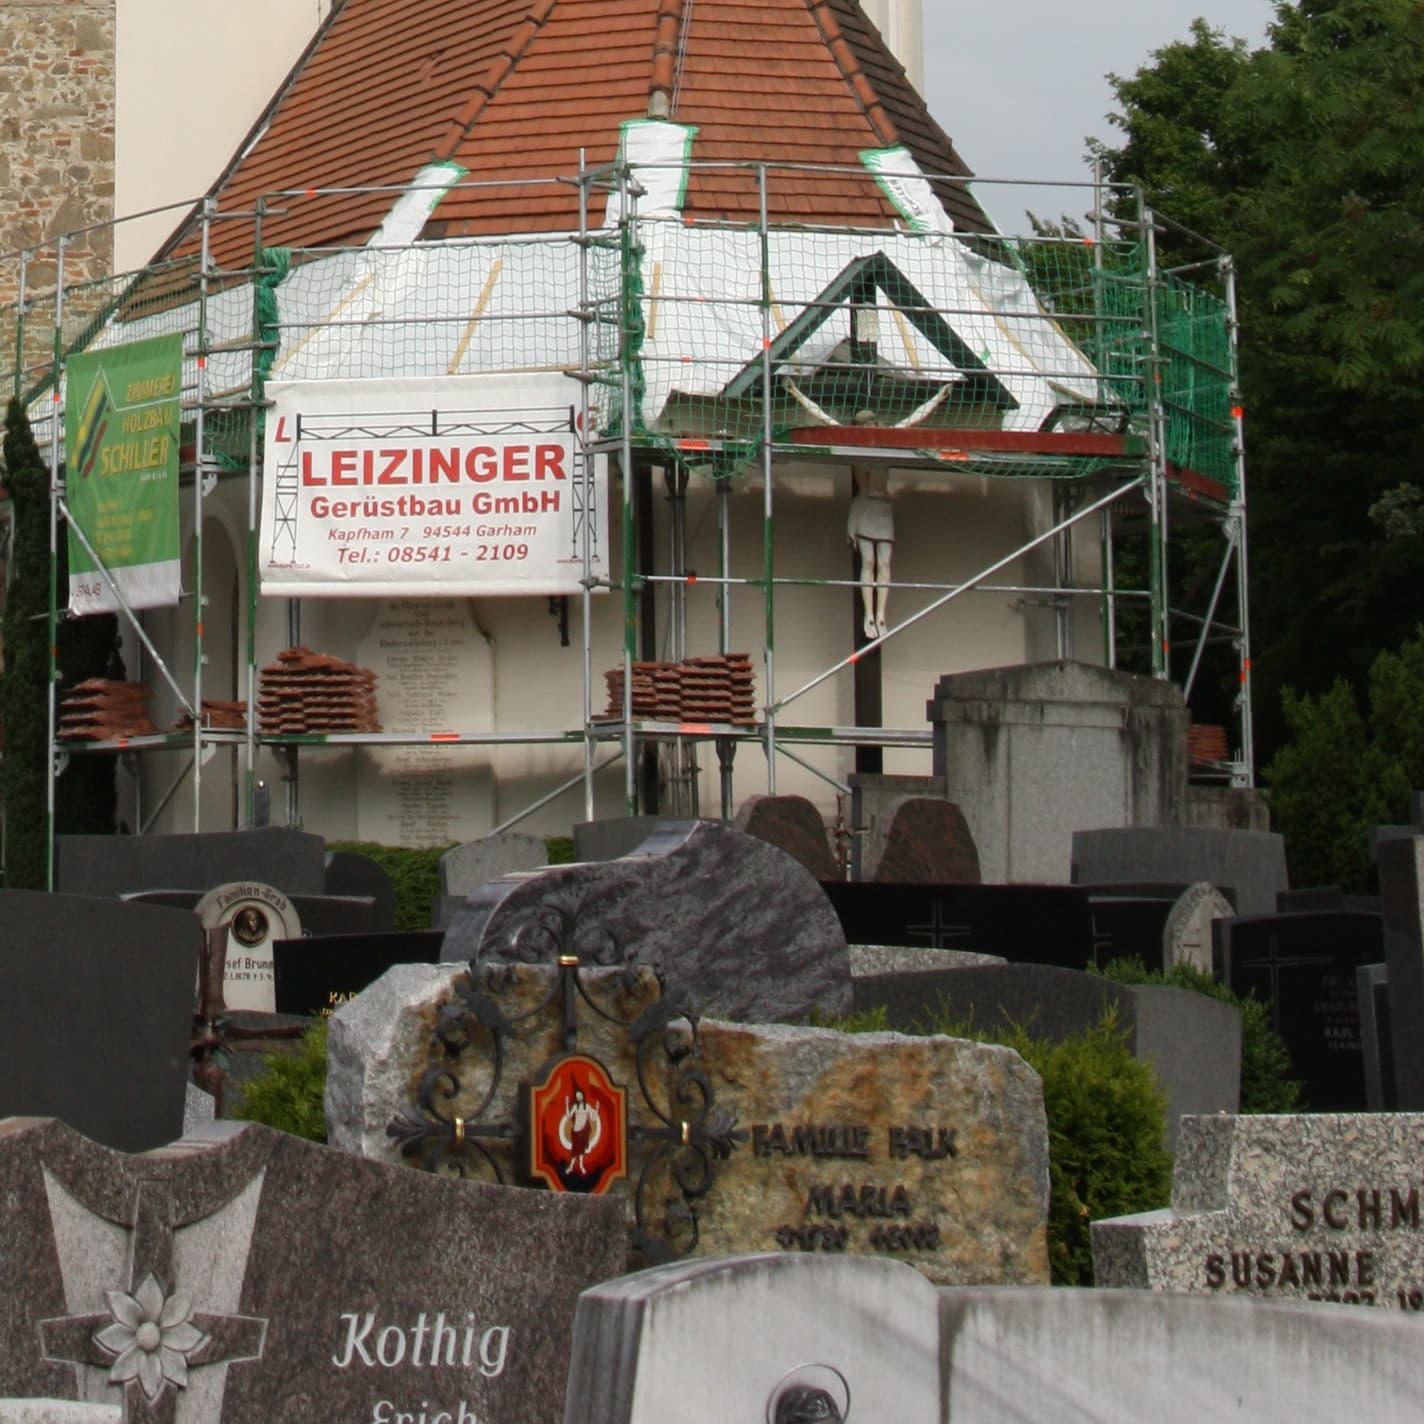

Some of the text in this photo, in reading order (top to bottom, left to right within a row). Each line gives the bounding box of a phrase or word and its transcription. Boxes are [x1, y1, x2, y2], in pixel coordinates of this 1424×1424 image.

[125, 374, 176, 403] ZIMMEREI
[123, 406, 172, 435] HOLZBAU
[275, 416, 292, 443] L
[100, 436, 169, 476] SCHILLER
[302, 444, 567, 487] LEIZINGER
[310, 490, 560, 518] Gerüstbau GmbH
[328, 524, 536, 543] Kapfham 7 94544 Garham
[337, 547, 378, 563] Tel.:
[387, 545, 451, 562] 08541
[476, 543, 528, 561] 2109
[751, 1123, 871, 1158] FAMILIE
[805, 1183, 913, 1218] MARIA
[1206, 1250, 1376, 1288] SUSANNE
[331, 1312, 512, 1378] Kothig
